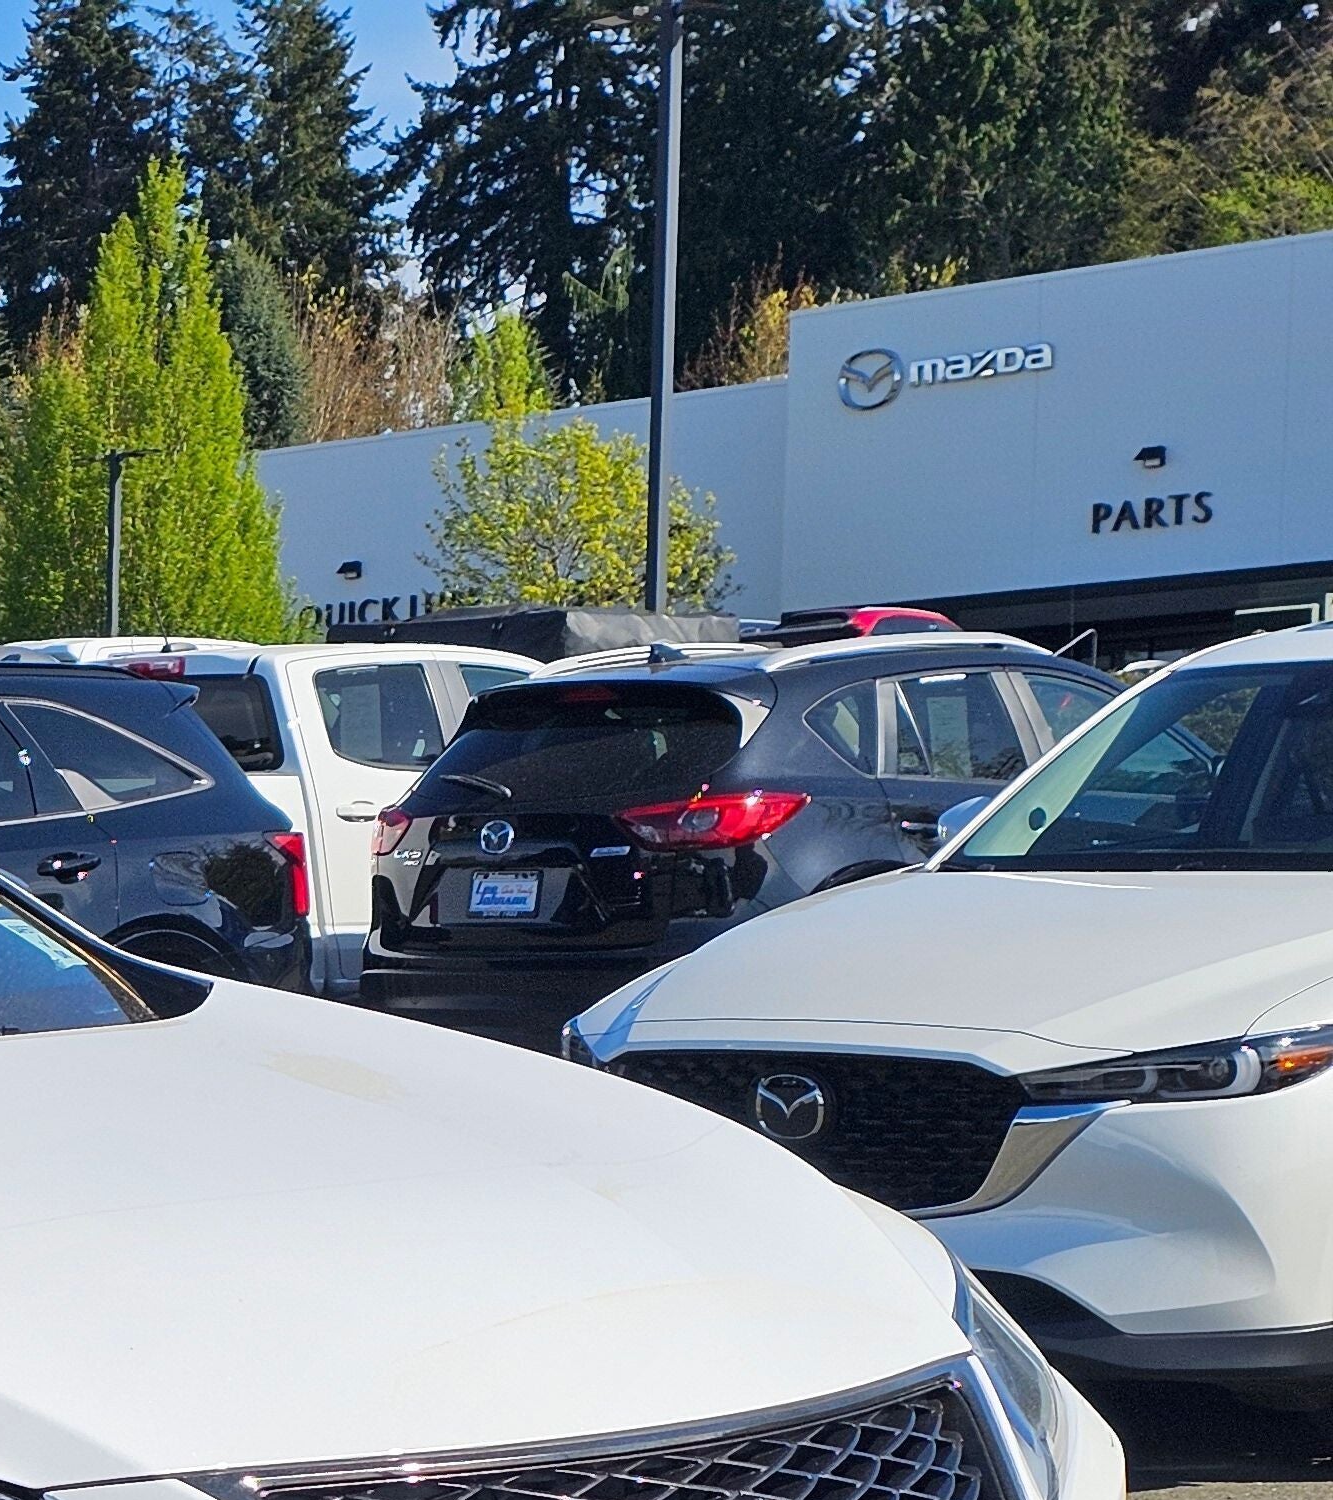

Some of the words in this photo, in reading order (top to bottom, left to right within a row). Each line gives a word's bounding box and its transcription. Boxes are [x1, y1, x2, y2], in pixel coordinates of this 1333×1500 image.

[909, 343, 1053, 385] mazda
[1091, 491, 1213, 534] PARTS
[298, 597, 401, 629] QUICK
